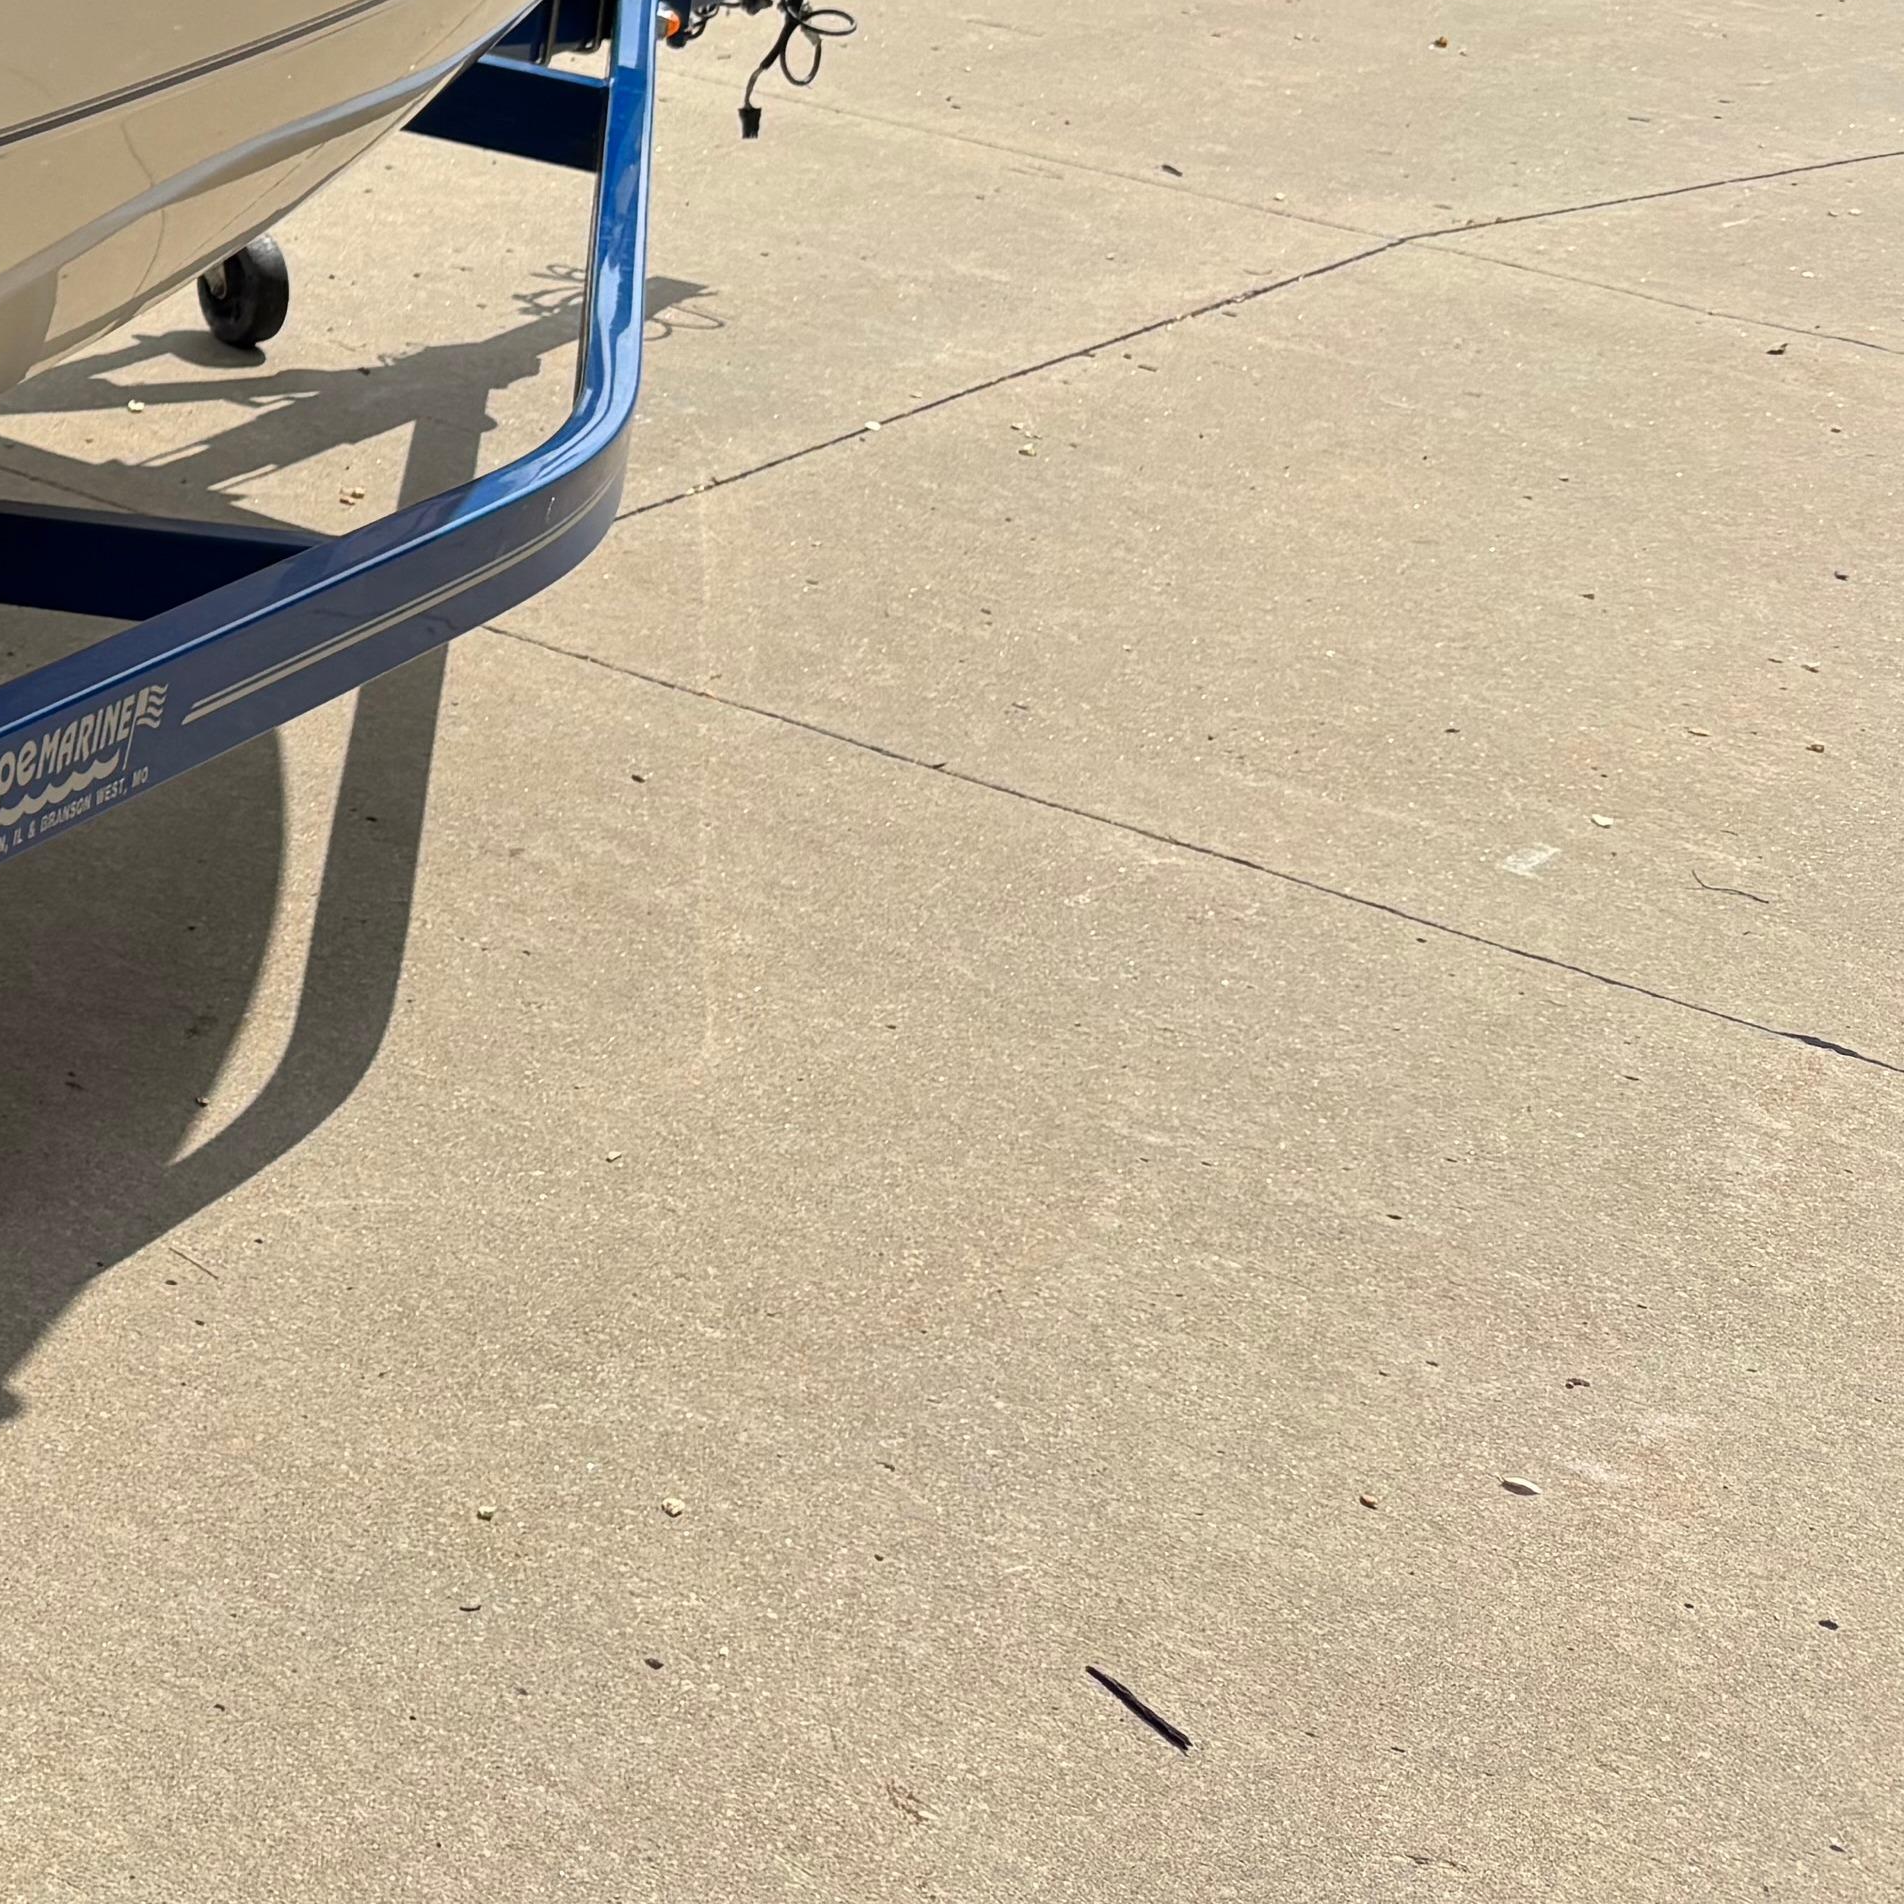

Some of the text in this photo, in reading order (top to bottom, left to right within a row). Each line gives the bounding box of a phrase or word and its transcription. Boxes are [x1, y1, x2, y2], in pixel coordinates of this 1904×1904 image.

[12, 827, 23, 846] IL
[27, 819, 36, 839] &
[39, 793, 92, 833] BRANSON
[131, 766, 149, 788] MO
